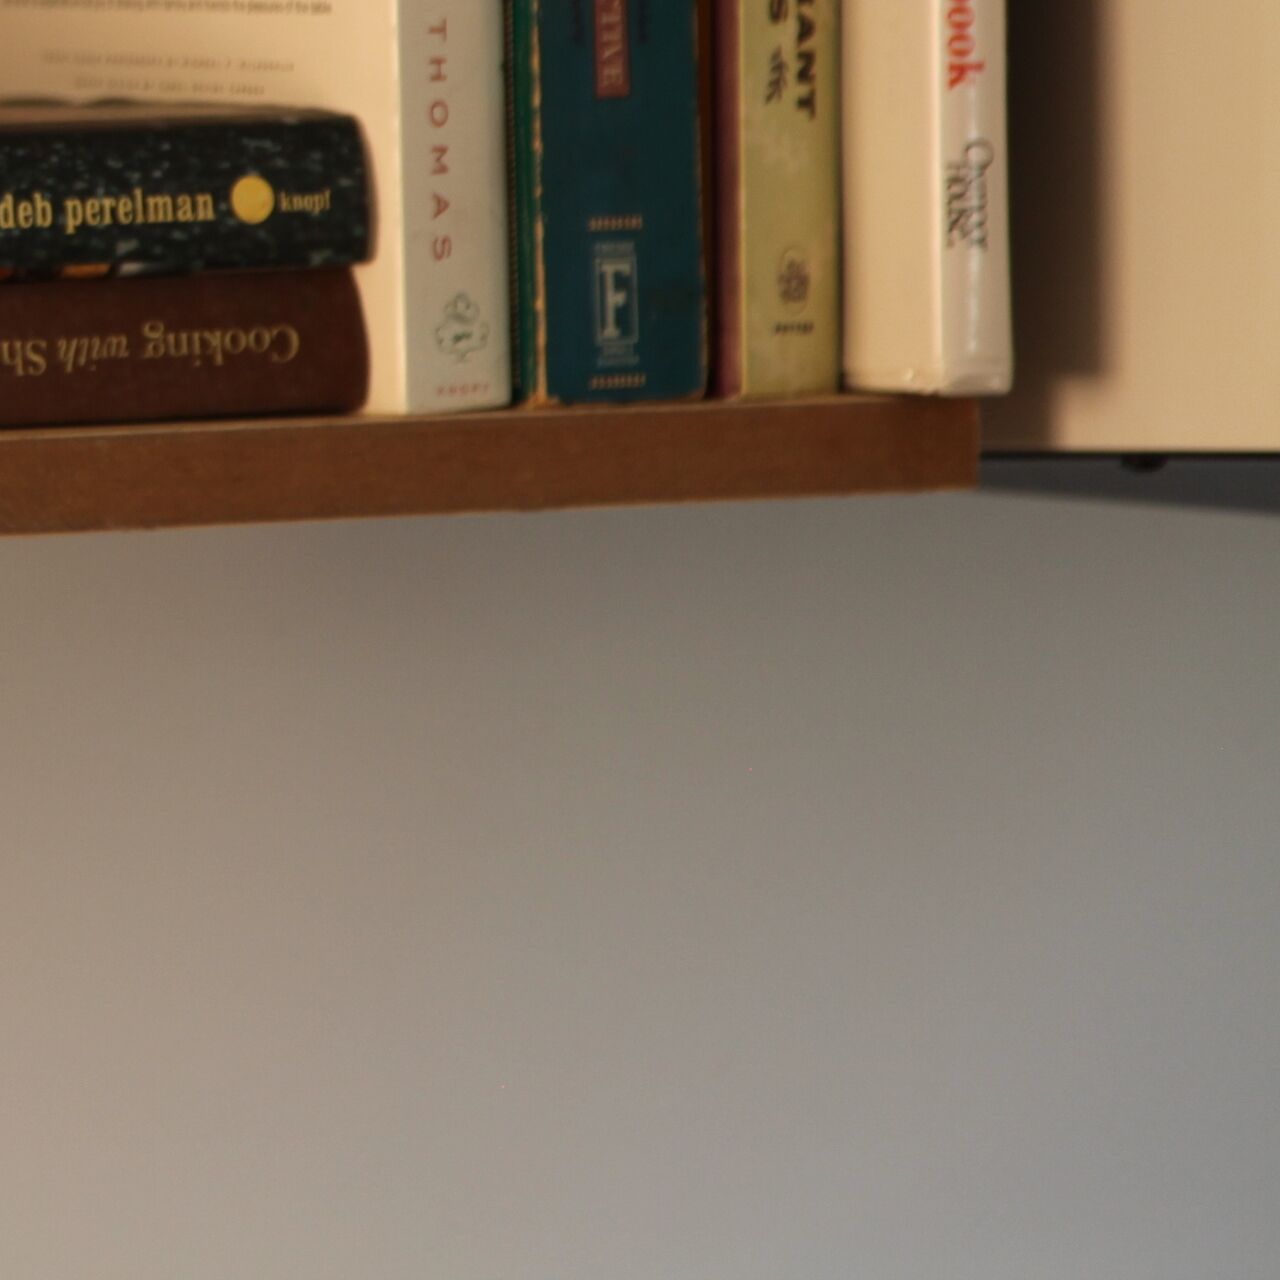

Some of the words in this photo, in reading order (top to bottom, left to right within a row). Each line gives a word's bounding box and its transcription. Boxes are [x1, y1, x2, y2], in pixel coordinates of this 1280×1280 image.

[427, 17, 452, 263] THOMAS
[65, 190, 215, 235] perelman
[279, 188, 332, 215] knopf
[57, 331, 129, 373] with
[143, 321, 300, 367] Cooking
